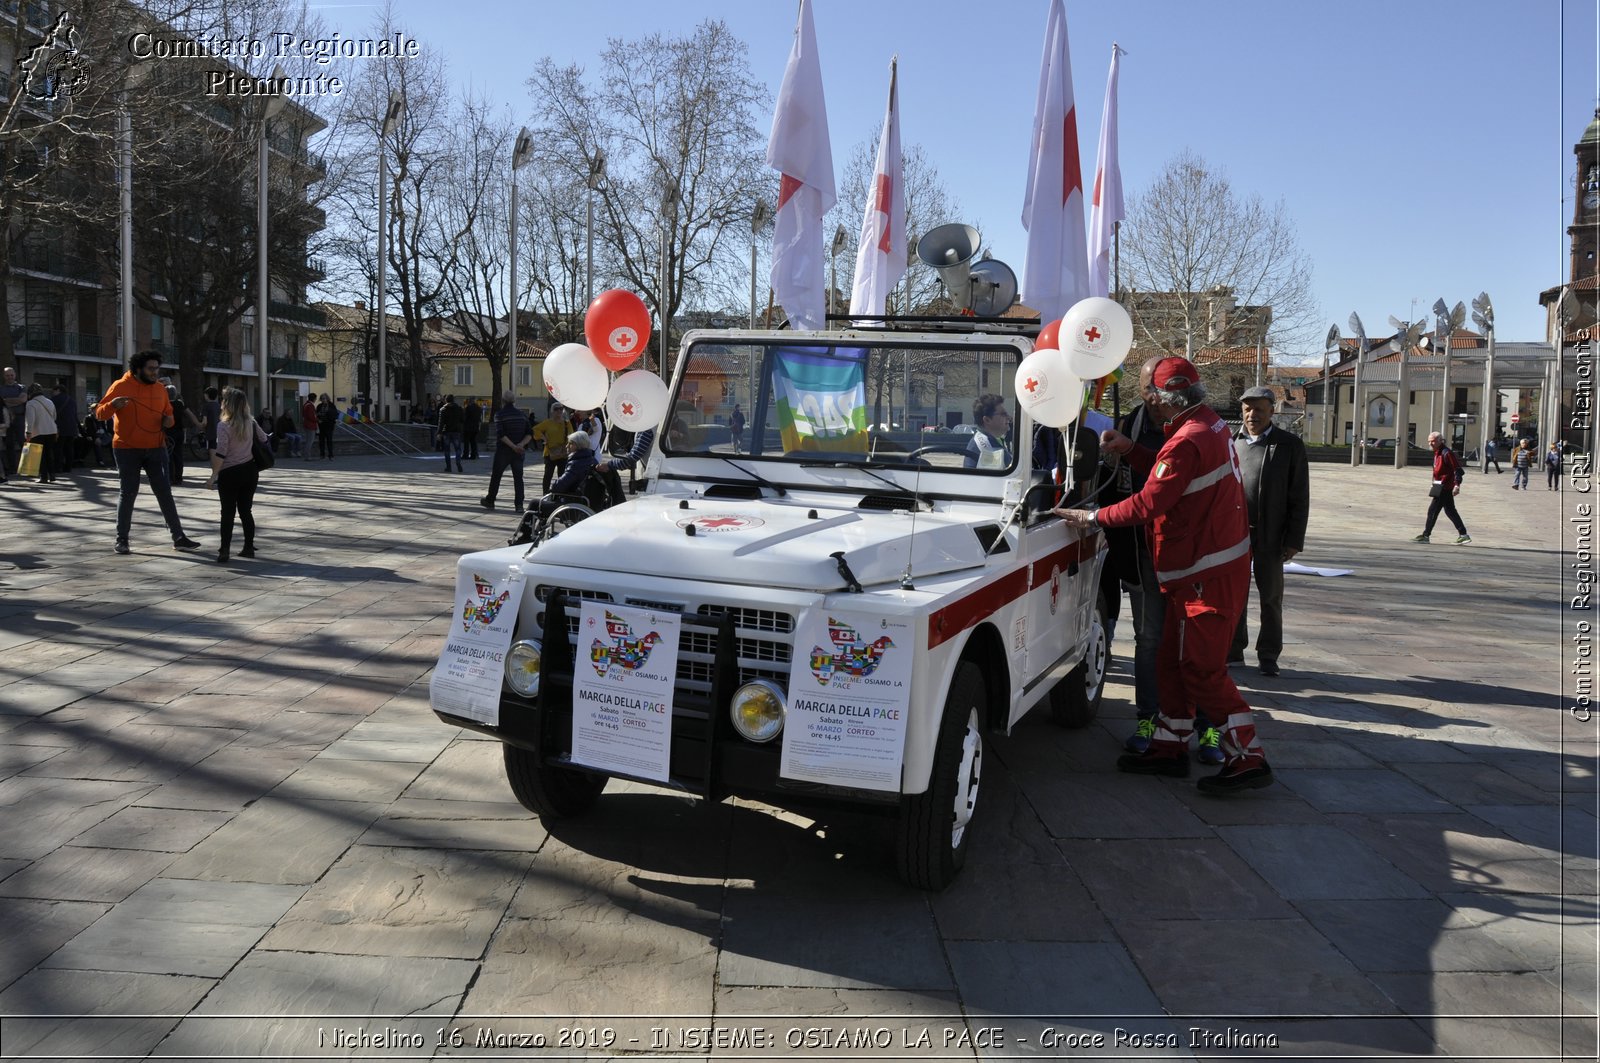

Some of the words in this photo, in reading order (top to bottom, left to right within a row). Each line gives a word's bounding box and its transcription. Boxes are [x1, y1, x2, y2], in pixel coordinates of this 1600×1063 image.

[447, 644, 468, 656] MARCIA
[469, 648, 486, 659] DELLA
[486, 651, 502, 663] PACE
[609, 674, 624, 682] PACE
[610, 667, 633, 677] INSIEME:
[636, 671, 658, 680] OSIAMO
[580, 690, 612, 704] MARCIA
[615, 696, 641, 709] DELLA
[643, 701, 665, 713] PACE
[600, 706, 619, 715] Sabato
[795, 700, 836, 714] MARCIA
[839, 705, 870, 717] DELLA
[874, 709, 899, 720] PACE
[598, 714, 619, 723] MARZO
[623, 718, 646, 728] CORTEO
[820, 716, 843, 724] Sabato
[816, 725, 842, 733] MARZO
